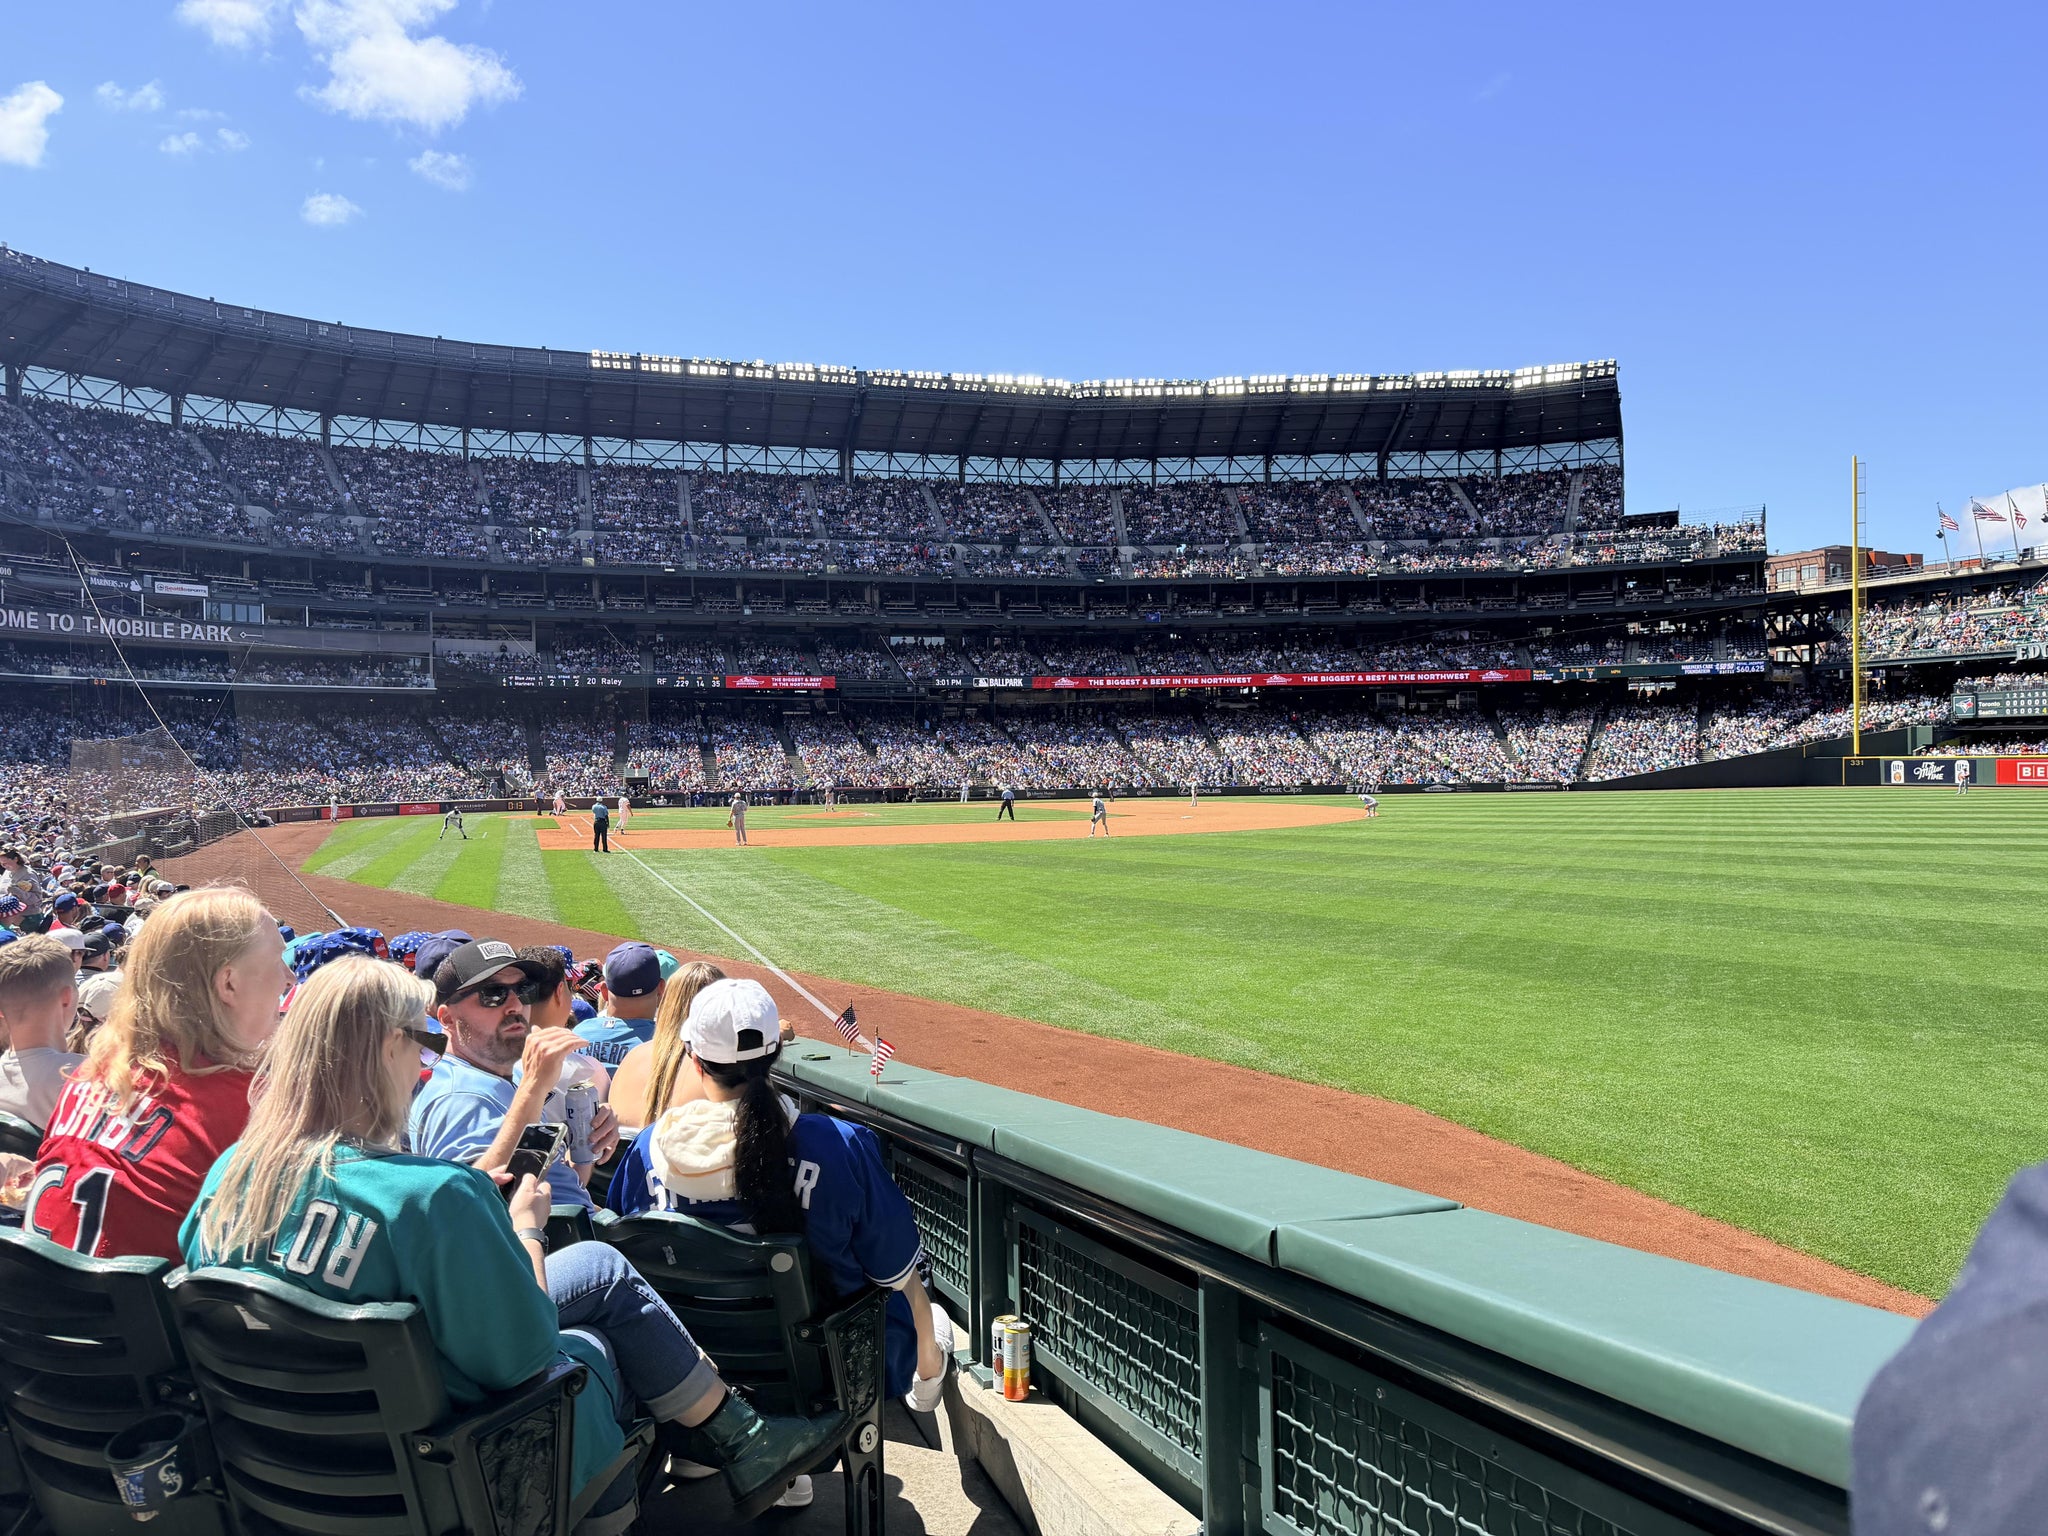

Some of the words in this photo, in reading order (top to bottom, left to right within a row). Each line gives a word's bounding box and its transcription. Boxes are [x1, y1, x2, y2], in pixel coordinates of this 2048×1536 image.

[47, 613, 75, 632] TO
[82, 615, 175, 639] T-MOBILE
[181, 623, 233, 642] PARK
[1736, 665, 1765, 673] $60,625
[601, 678, 622, 686] Raley
[989, 678, 1023, 687] BALLPARK
[1913, 765, 1945, 780] Miller
[1283, 785, 1303, 794] Clips
[1345, 785, 1382, 793] STIHL
[865, 1431, 872, 1446] 9
